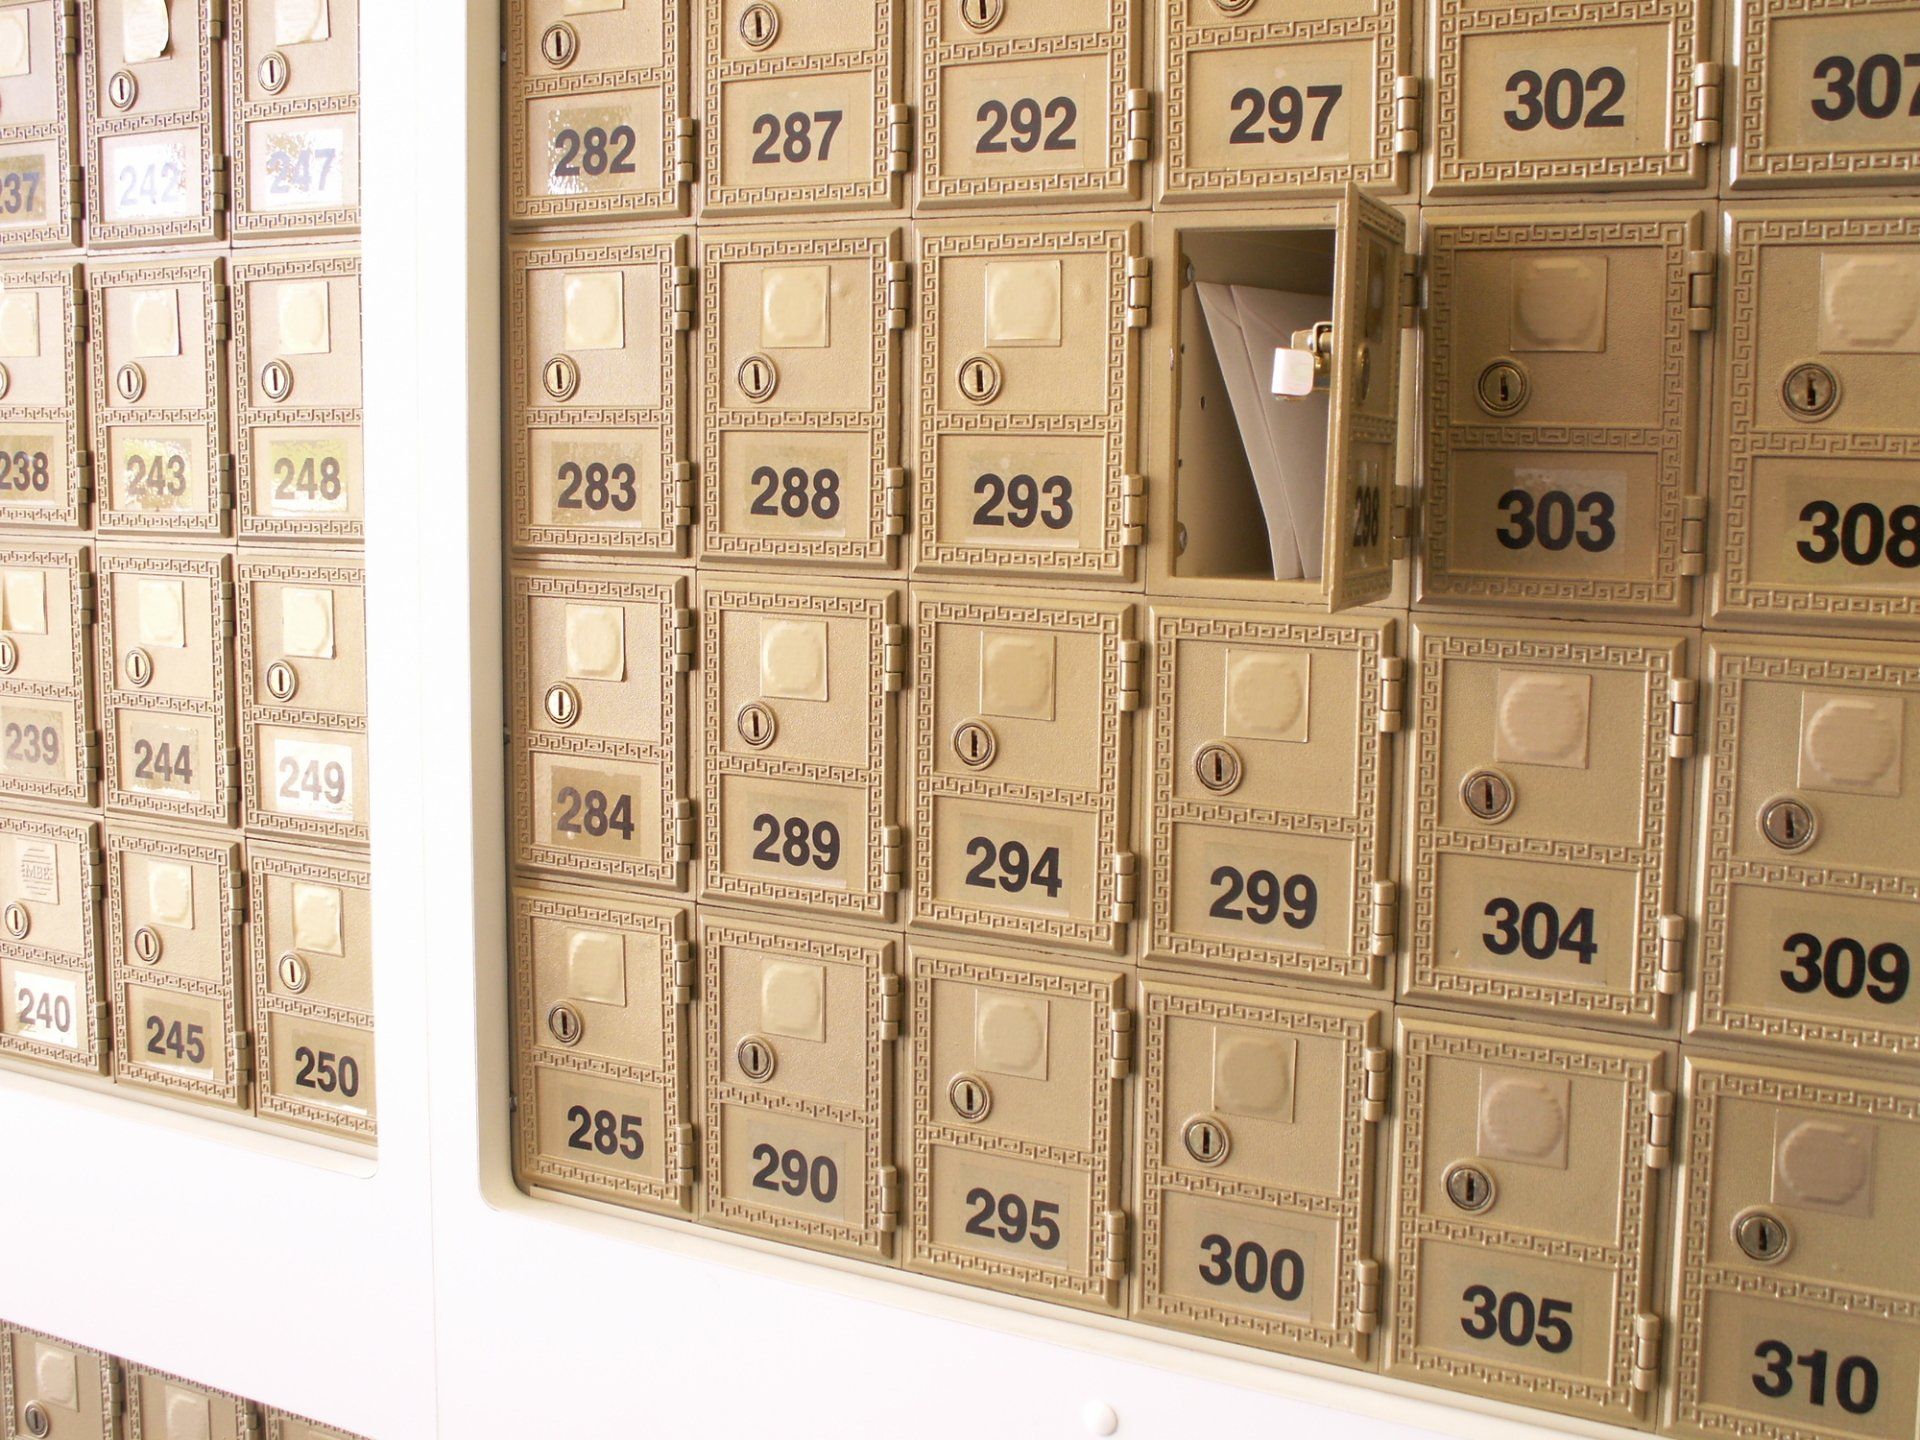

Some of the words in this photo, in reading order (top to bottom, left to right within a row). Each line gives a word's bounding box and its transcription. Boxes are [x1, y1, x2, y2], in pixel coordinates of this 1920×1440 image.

[976, 96, 1077, 153] 292
[1229, 85, 1343, 144] 297
[1504, 67, 1625, 130] 302
[554, 125, 636, 176] 282
[752, 110, 843, 164] 287
[0, 172, 40, 213] 37
[119, 162, 180, 206] 242
[270, 147, 337, 194] 247
[0, 451, 49, 491] 238
[126, 455, 187, 497] 243
[274, 456, 341, 500] 248
[557, 461, 637, 512] 283
[750, 466, 840, 519] 288
[973, 473, 1073, 529] 293
[1353, 485, 1380, 547] 298
[1496, 489, 1616, 552] 303
[1796, 500, 1920, 569] 308
[5, 723, 60, 765] 239
[134, 739, 193, 784] 244
[278, 756, 346, 803] 249
[557, 786, 634, 840] 284
[753, 813, 840, 870] 289
[965, 837, 1062, 897] 294
[1209, 865, 1318, 929] 299
[1482, 897, 1598, 964] 304
[1780, 932, 1910, 1003] 309
[18, 988, 70, 1032] 240
[146, 1016, 205, 1063] 245
[295, 1046, 359, 1097] 250
[567, 1104, 644, 1160] 285
[752, 1143, 838, 1203] 290
[965, 1188, 1060, 1250] 295
[1199, 1234, 1305, 1300] 300
[1460, 1285, 1573, 1353] 305
[1752, 1340, 1879, 1414] 310
